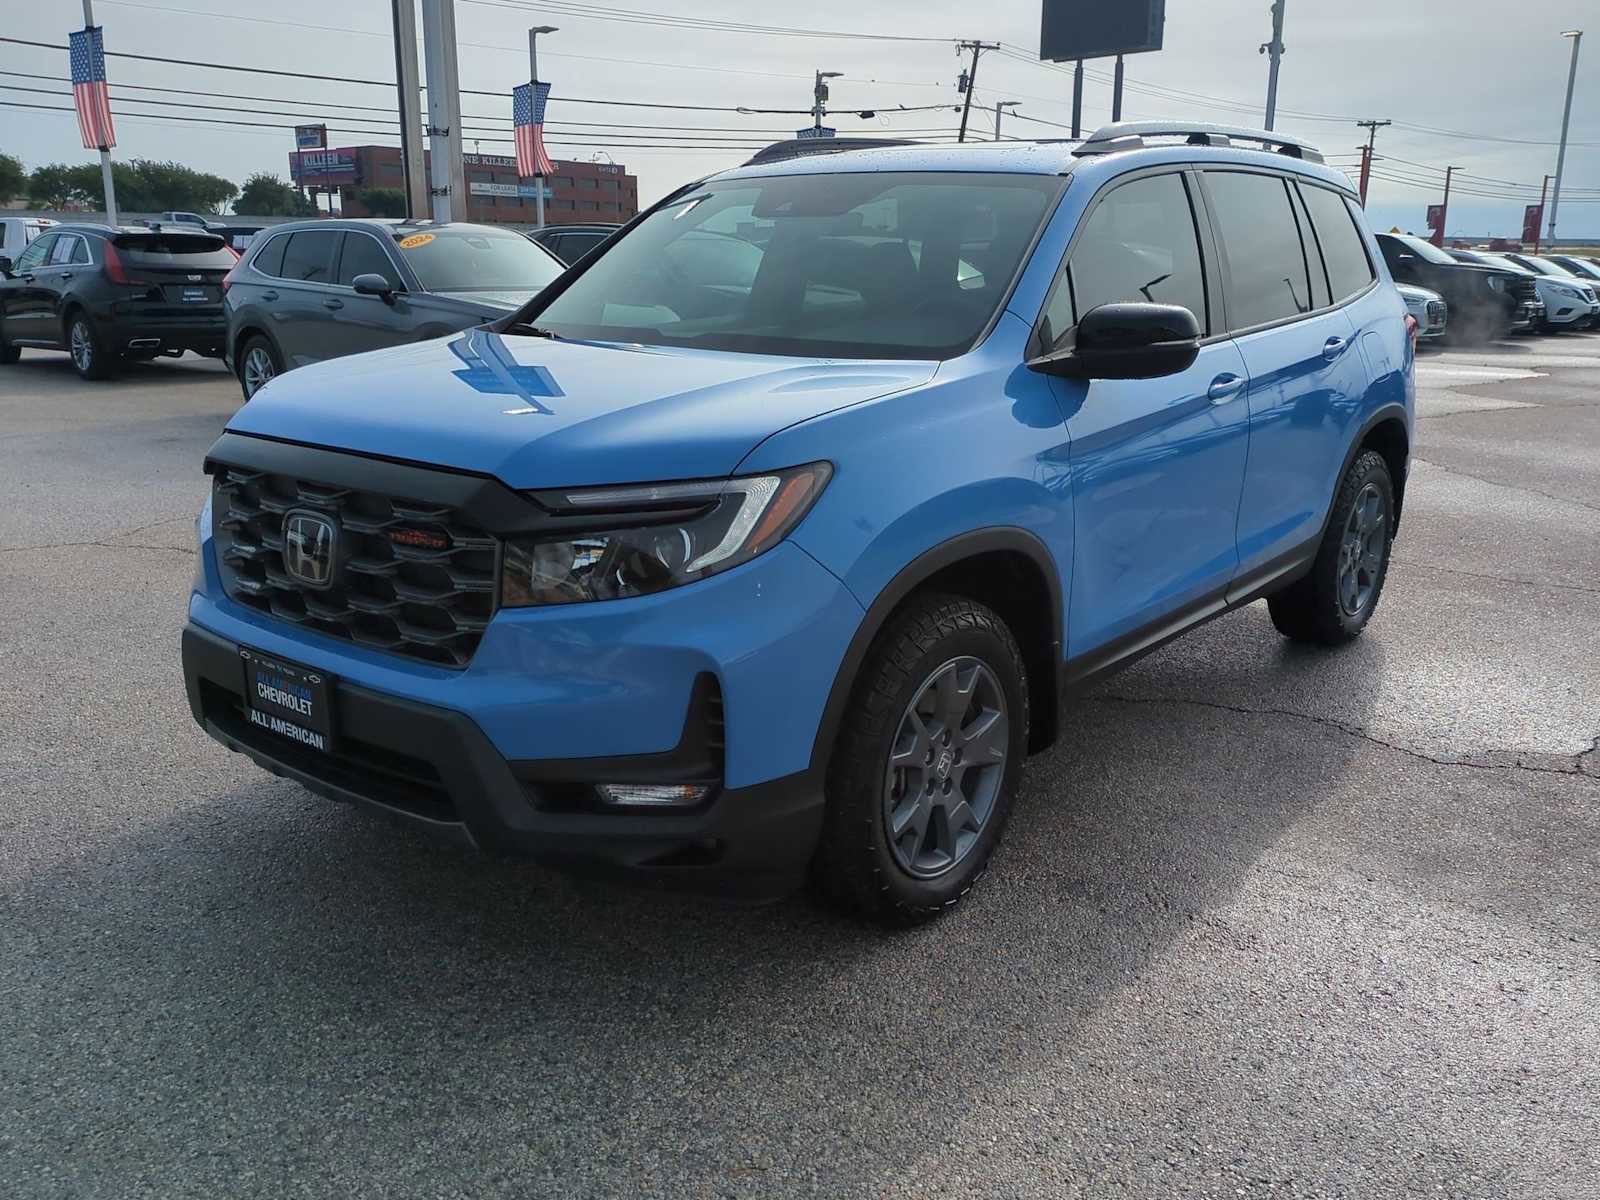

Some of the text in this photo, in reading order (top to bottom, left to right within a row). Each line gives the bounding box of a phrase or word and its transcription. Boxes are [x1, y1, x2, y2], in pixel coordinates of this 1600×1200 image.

[463, 155, 518, 167] NE KILLEE
[403, 234, 433, 247] 2024
[257, 682, 312, 716] CHEVROLET
[250, 709, 324, 750] ALL AMERICAN
